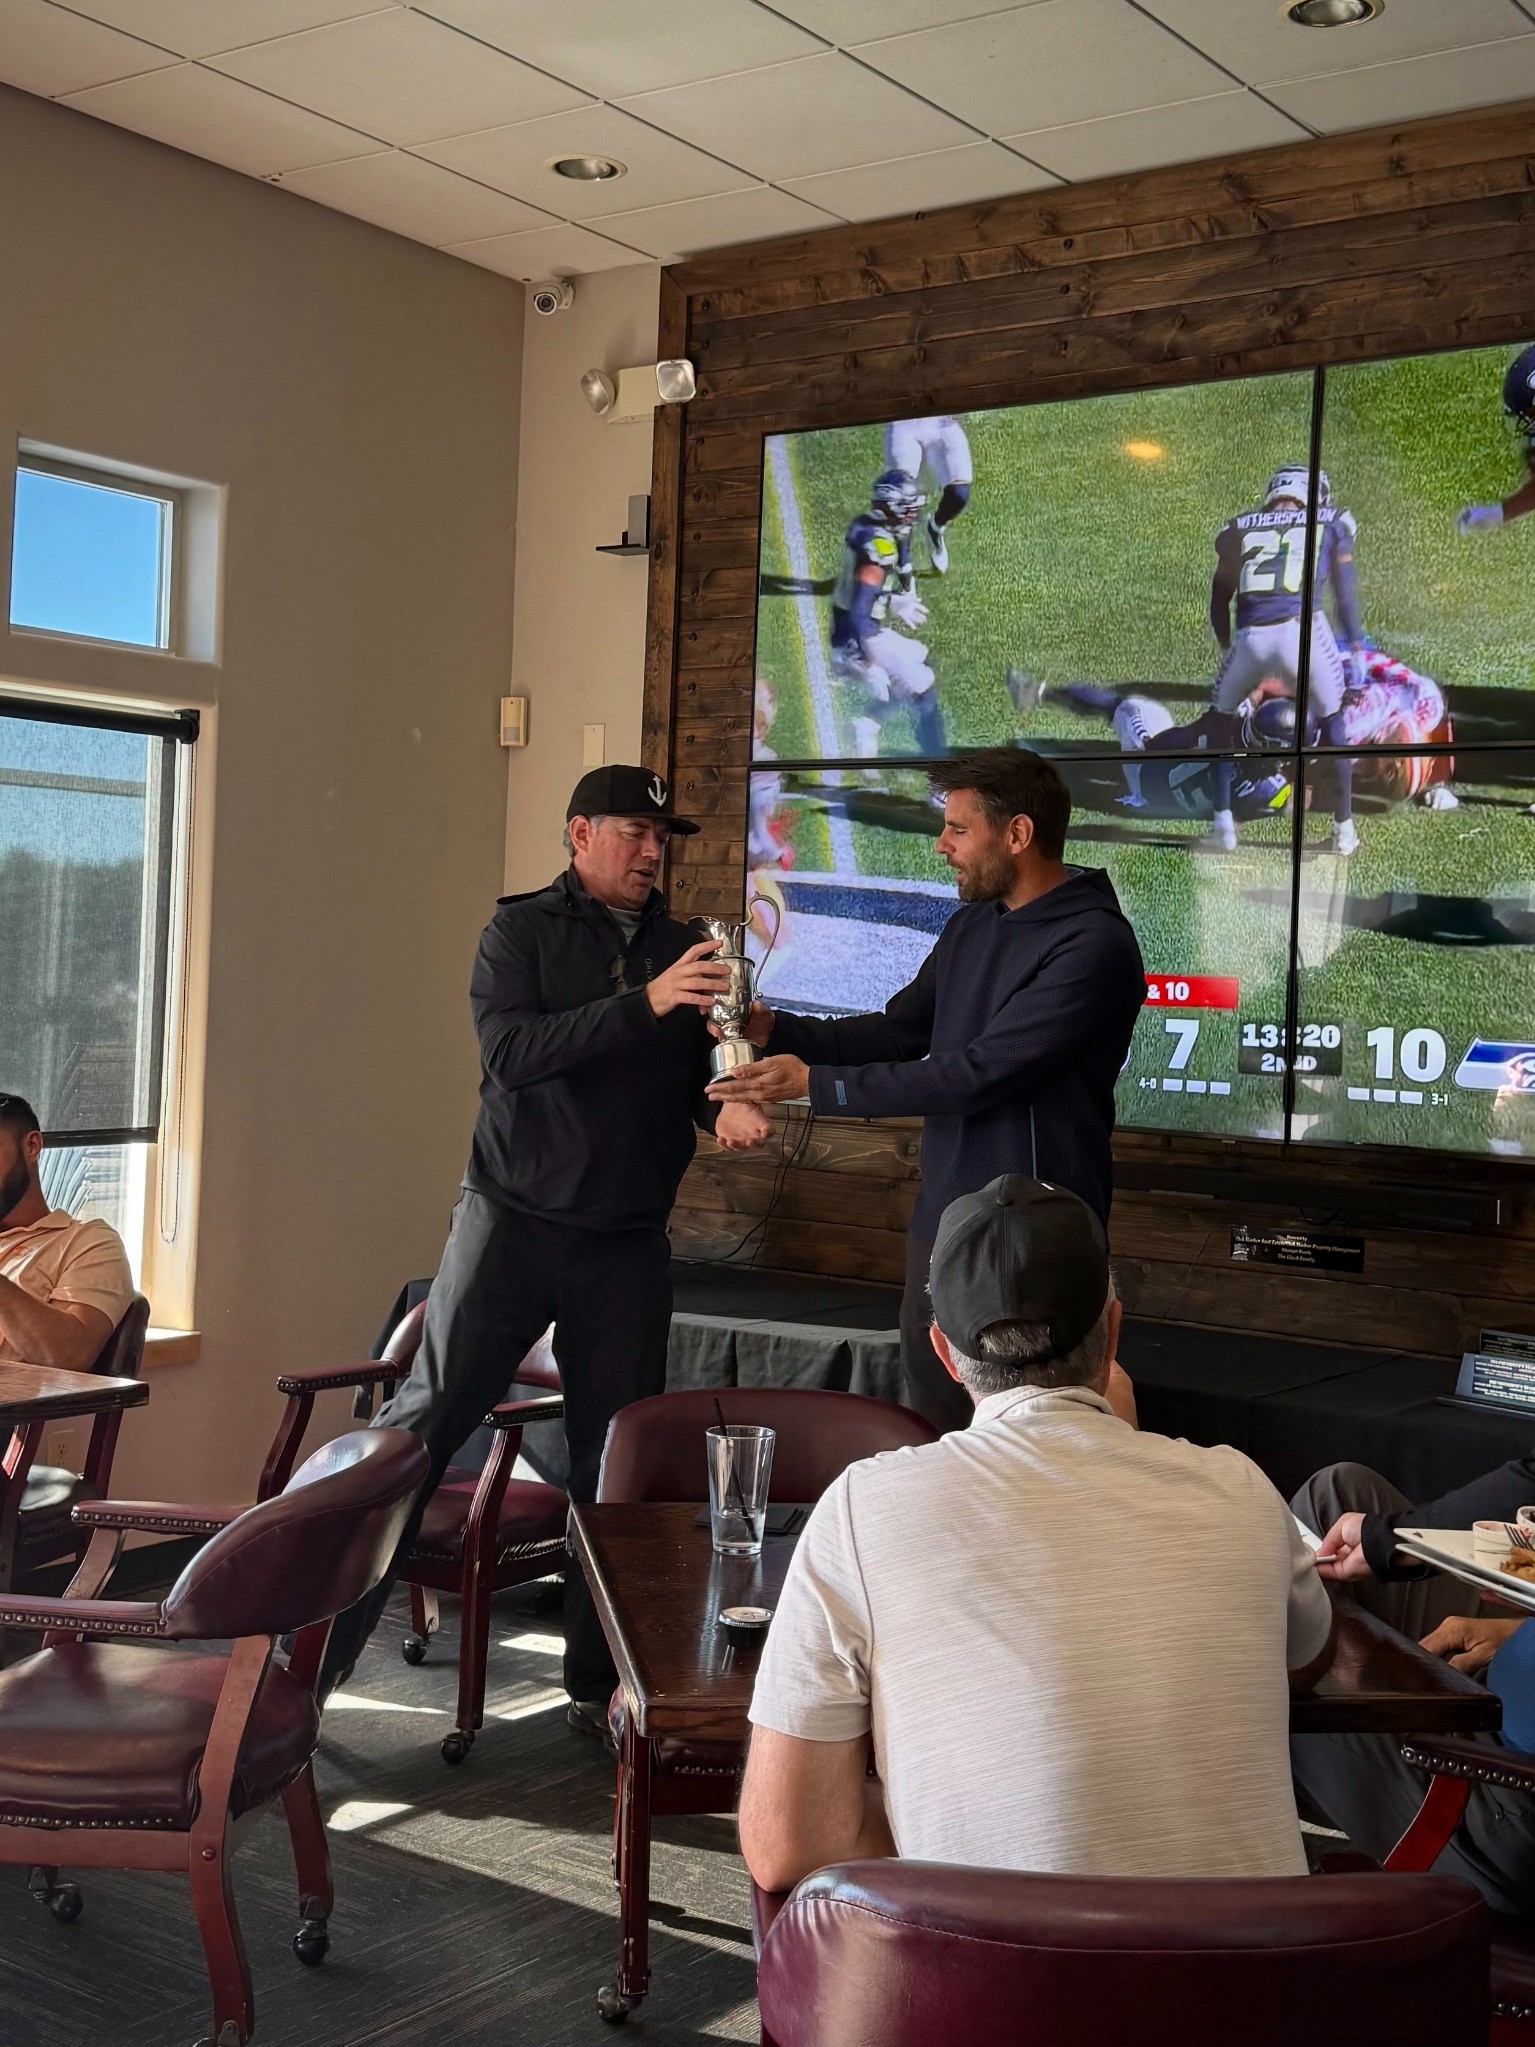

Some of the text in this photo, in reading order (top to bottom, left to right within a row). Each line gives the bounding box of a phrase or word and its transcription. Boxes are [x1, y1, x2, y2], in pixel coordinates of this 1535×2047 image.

[1239, 524, 1324, 592] 21
[1147, 981, 1190, 1001] & 10
[1165, 1018, 1200, 1070] 7
[1242, 1023, 1341, 1049] 13:20
[1261, 1052, 1317, 1072] 2ND
[1367, 1026, 1447, 1083] 10
[1138, 1077, 1157, 1090] 4-0
[1431, 1092, 1449, 1106] 3-1
